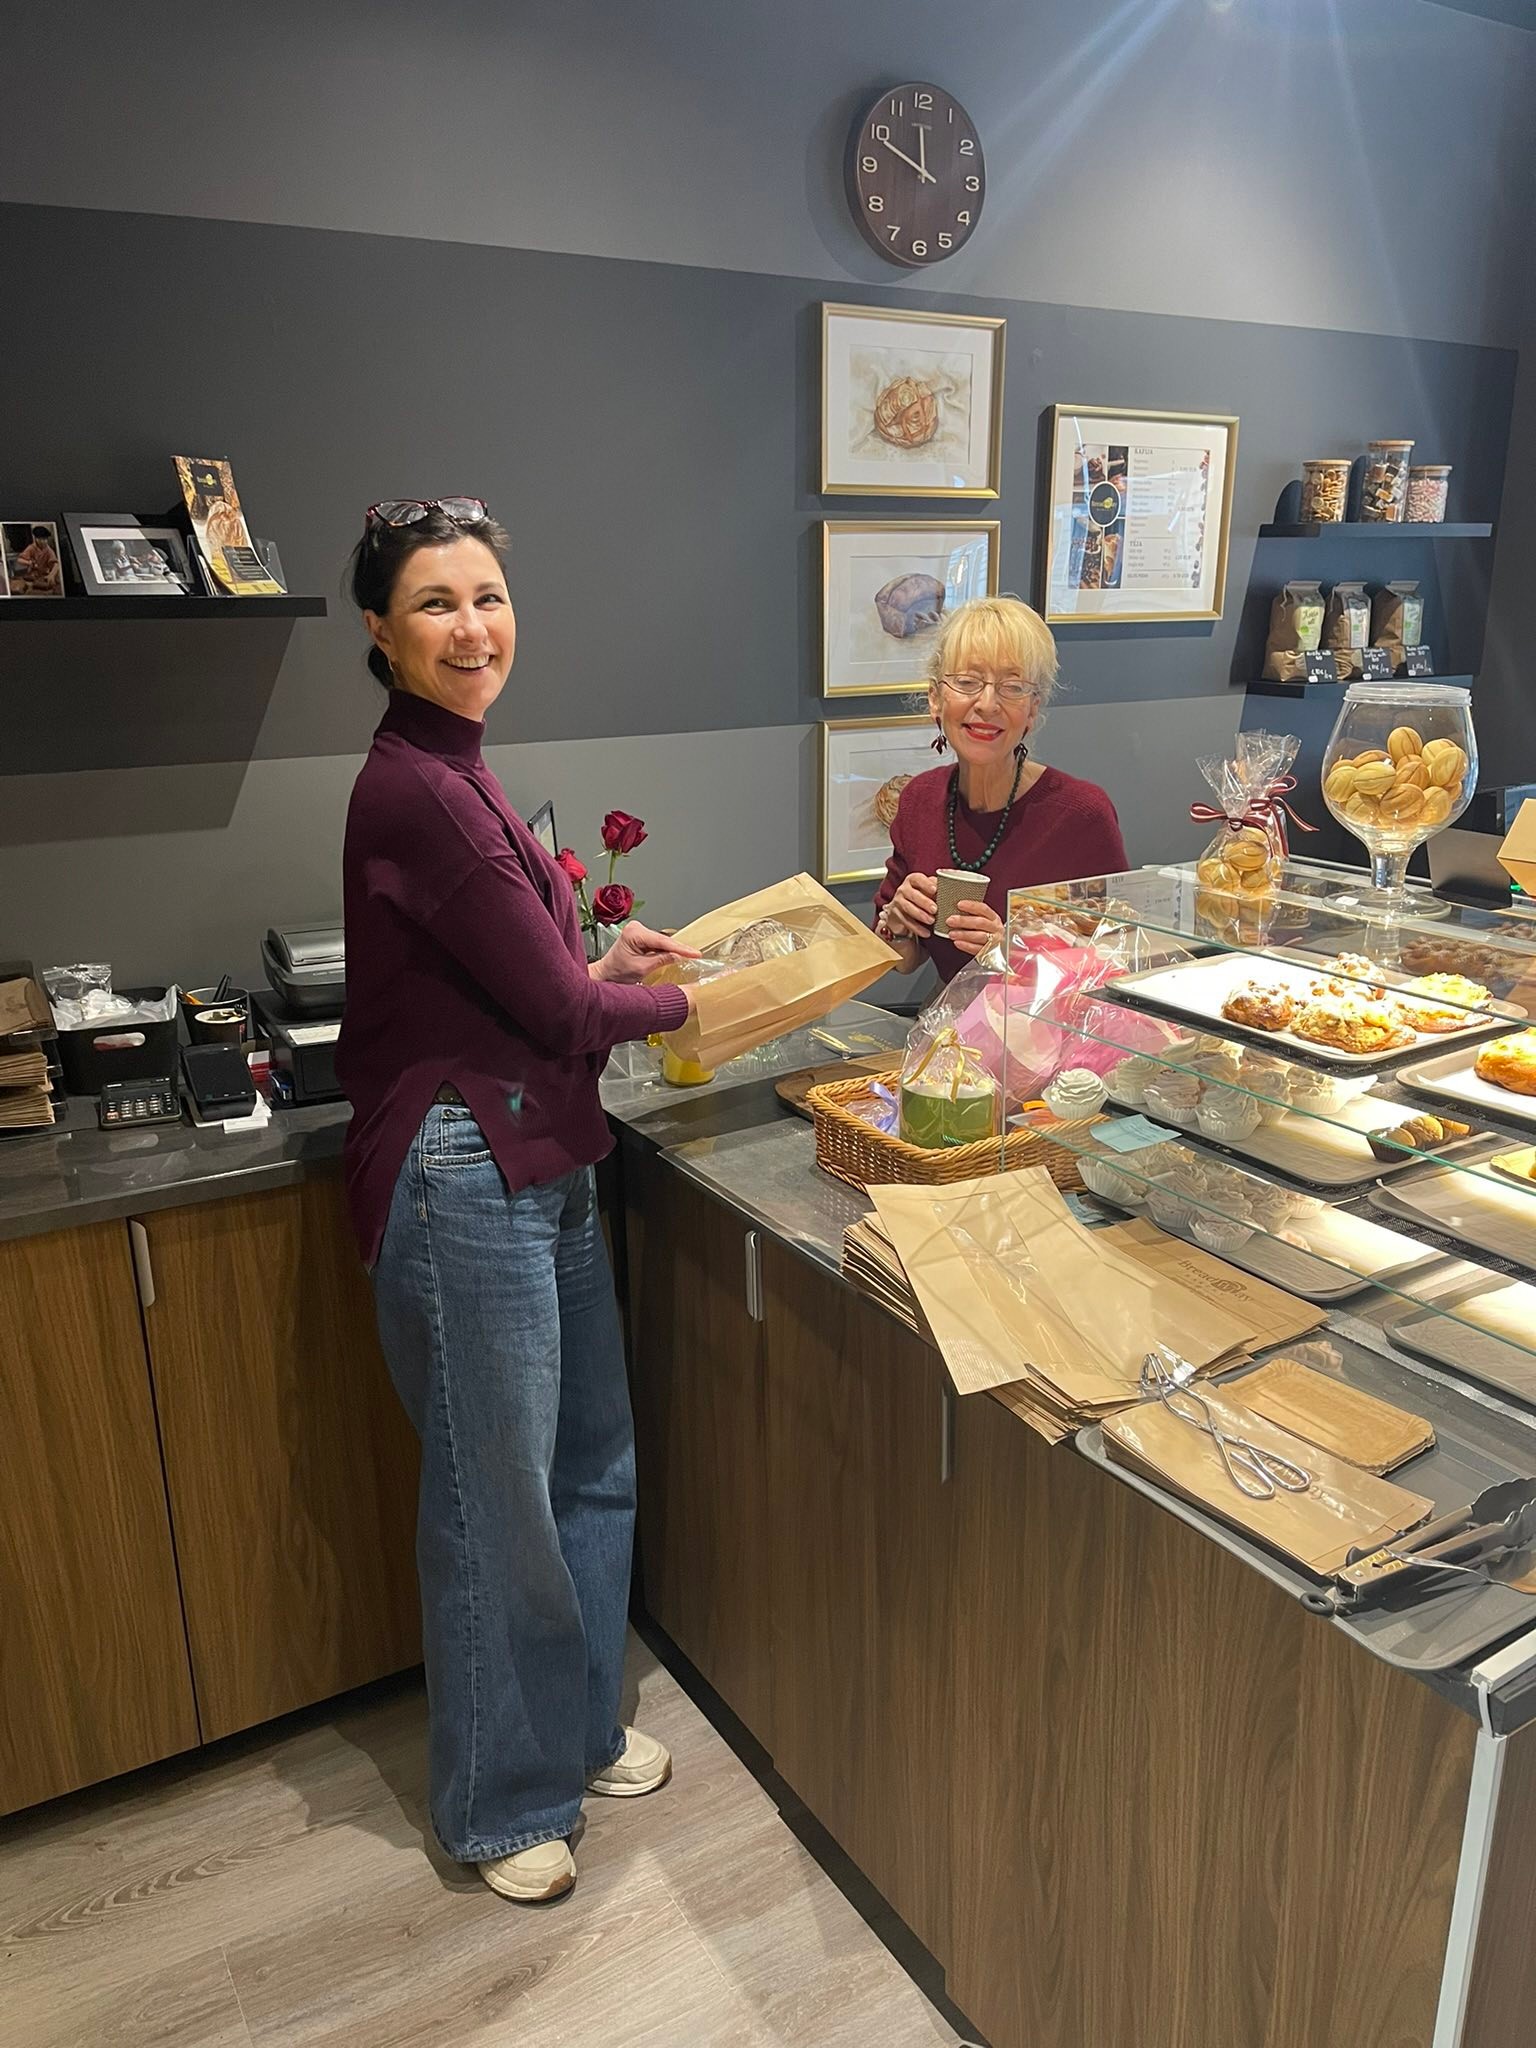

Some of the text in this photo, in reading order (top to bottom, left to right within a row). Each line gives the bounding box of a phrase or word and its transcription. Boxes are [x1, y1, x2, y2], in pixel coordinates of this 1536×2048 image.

[891, 99, 903, 117] 11
[914, 91, 933, 111] 12
[948, 107, 953, 124] 1
[871, 123, 890, 142] 10
[958, 138, 975, 156] 2
[862, 156, 878, 173] 9
[965, 175, 980, 192] 3
[868, 195, 884, 213] 8
[957, 210, 971, 226] 4
[886, 224, 901, 241] 7
[938, 232, 953, 249] 5
[912, 240, 927, 256] 6
